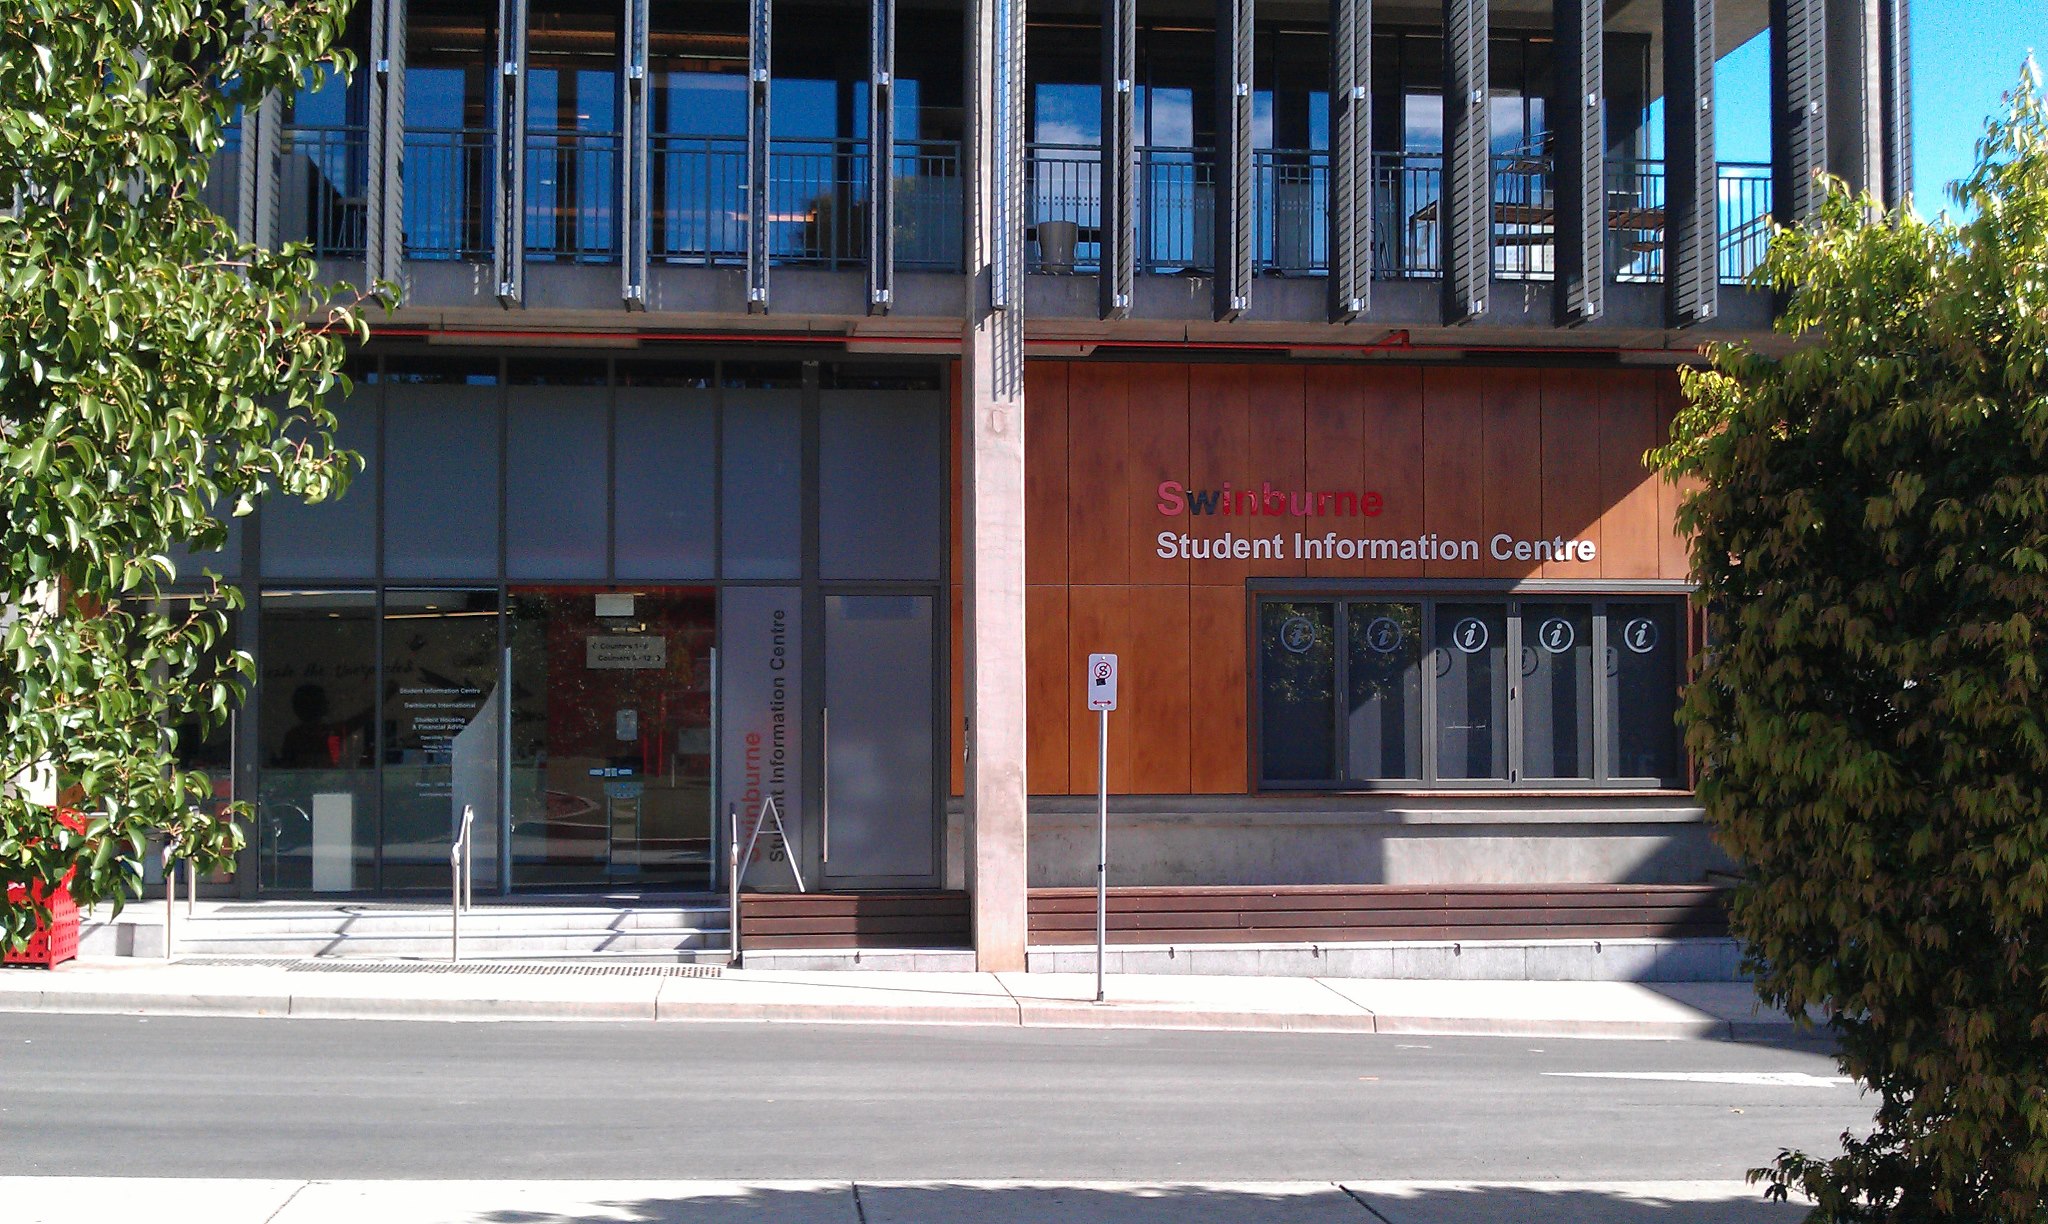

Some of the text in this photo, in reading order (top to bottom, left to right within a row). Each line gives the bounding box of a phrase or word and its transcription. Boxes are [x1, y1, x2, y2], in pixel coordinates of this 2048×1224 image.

[1157, 480, 1384, 517] Swinburne
[1156, 531, 1597, 562] Student Information Centre
[769, 609, 785, 670] Centre
[460, 687, 481, 695] Centre
[769, 677, 785, 783] Information
